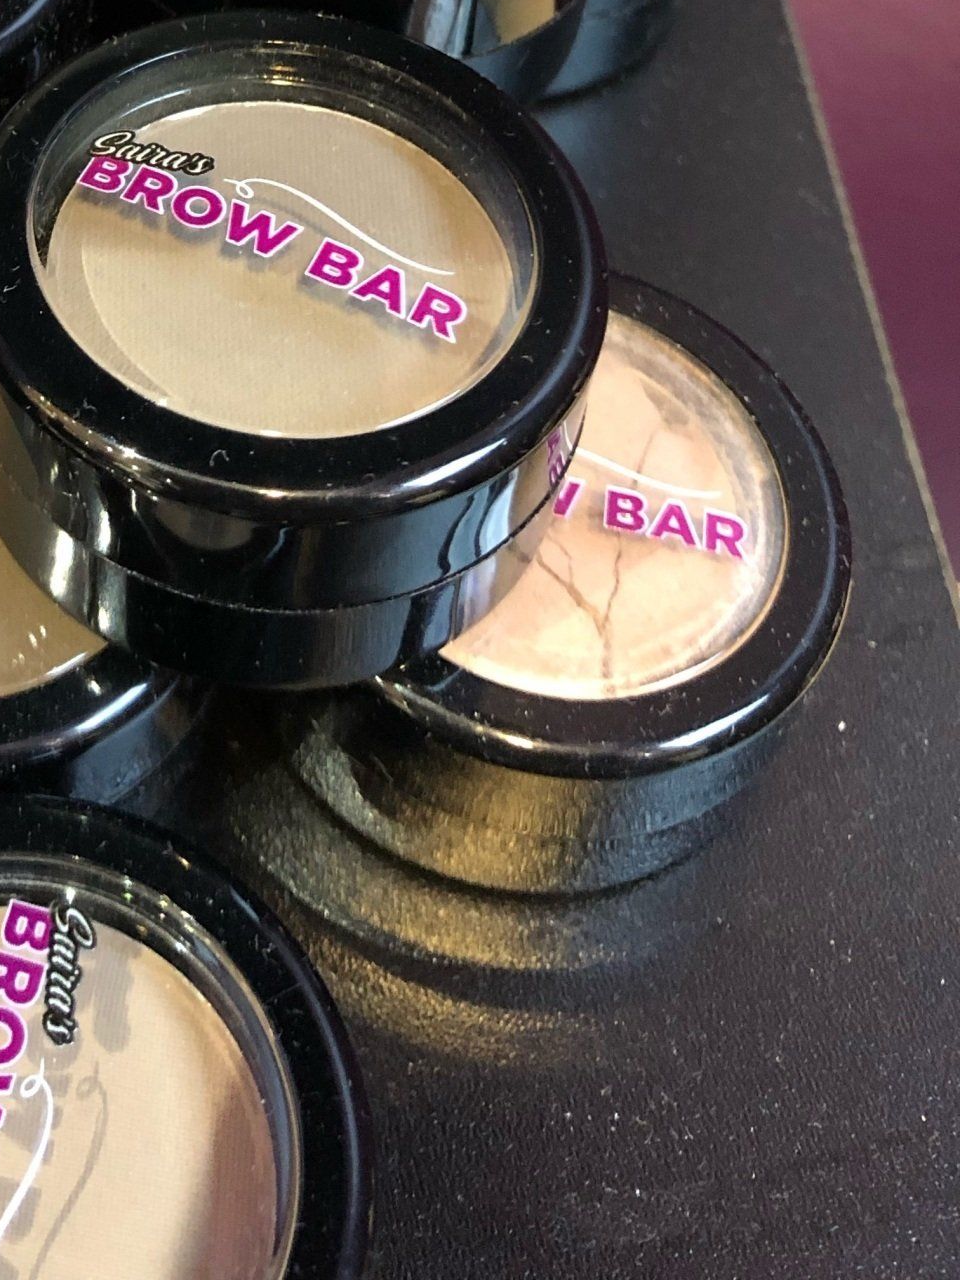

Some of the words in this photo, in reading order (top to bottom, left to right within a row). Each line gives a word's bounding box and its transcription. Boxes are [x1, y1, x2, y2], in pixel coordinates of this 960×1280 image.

[90, 129, 215, 176] Saira's
[76, 155, 304, 258] BROW
[304, 236, 468, 344] BAR
[603, 485, 756, 570] BAR
[42, 902, 97, 1045] Saira's
